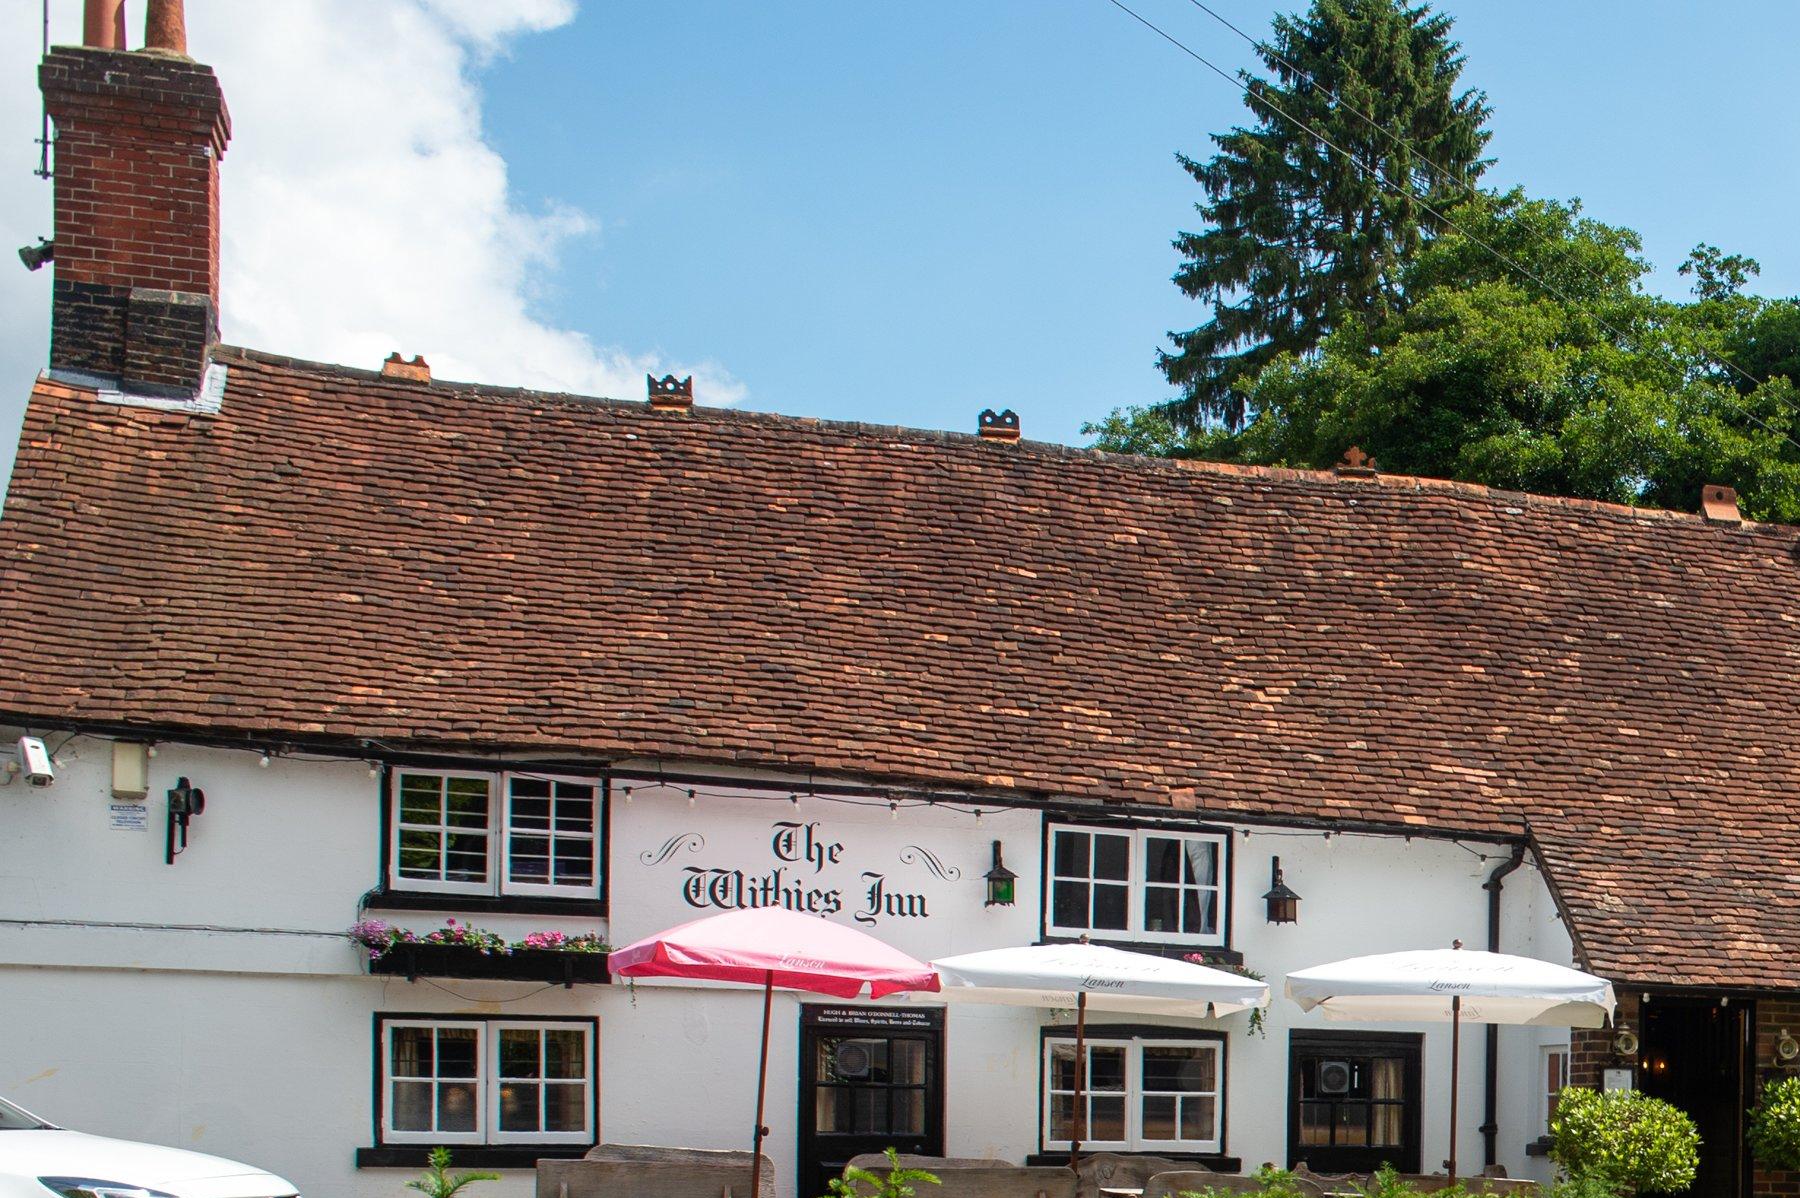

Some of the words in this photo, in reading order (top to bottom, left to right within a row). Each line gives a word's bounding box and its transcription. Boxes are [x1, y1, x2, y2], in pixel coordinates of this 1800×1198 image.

[772, 821, 845, 874] The
[682, 866, 844, 918] Withies
[854, 871, 930, 927] Inn
[1081, 975, 1126, 989] Lanson
[1429, 979, 1472, 992] Lanson
